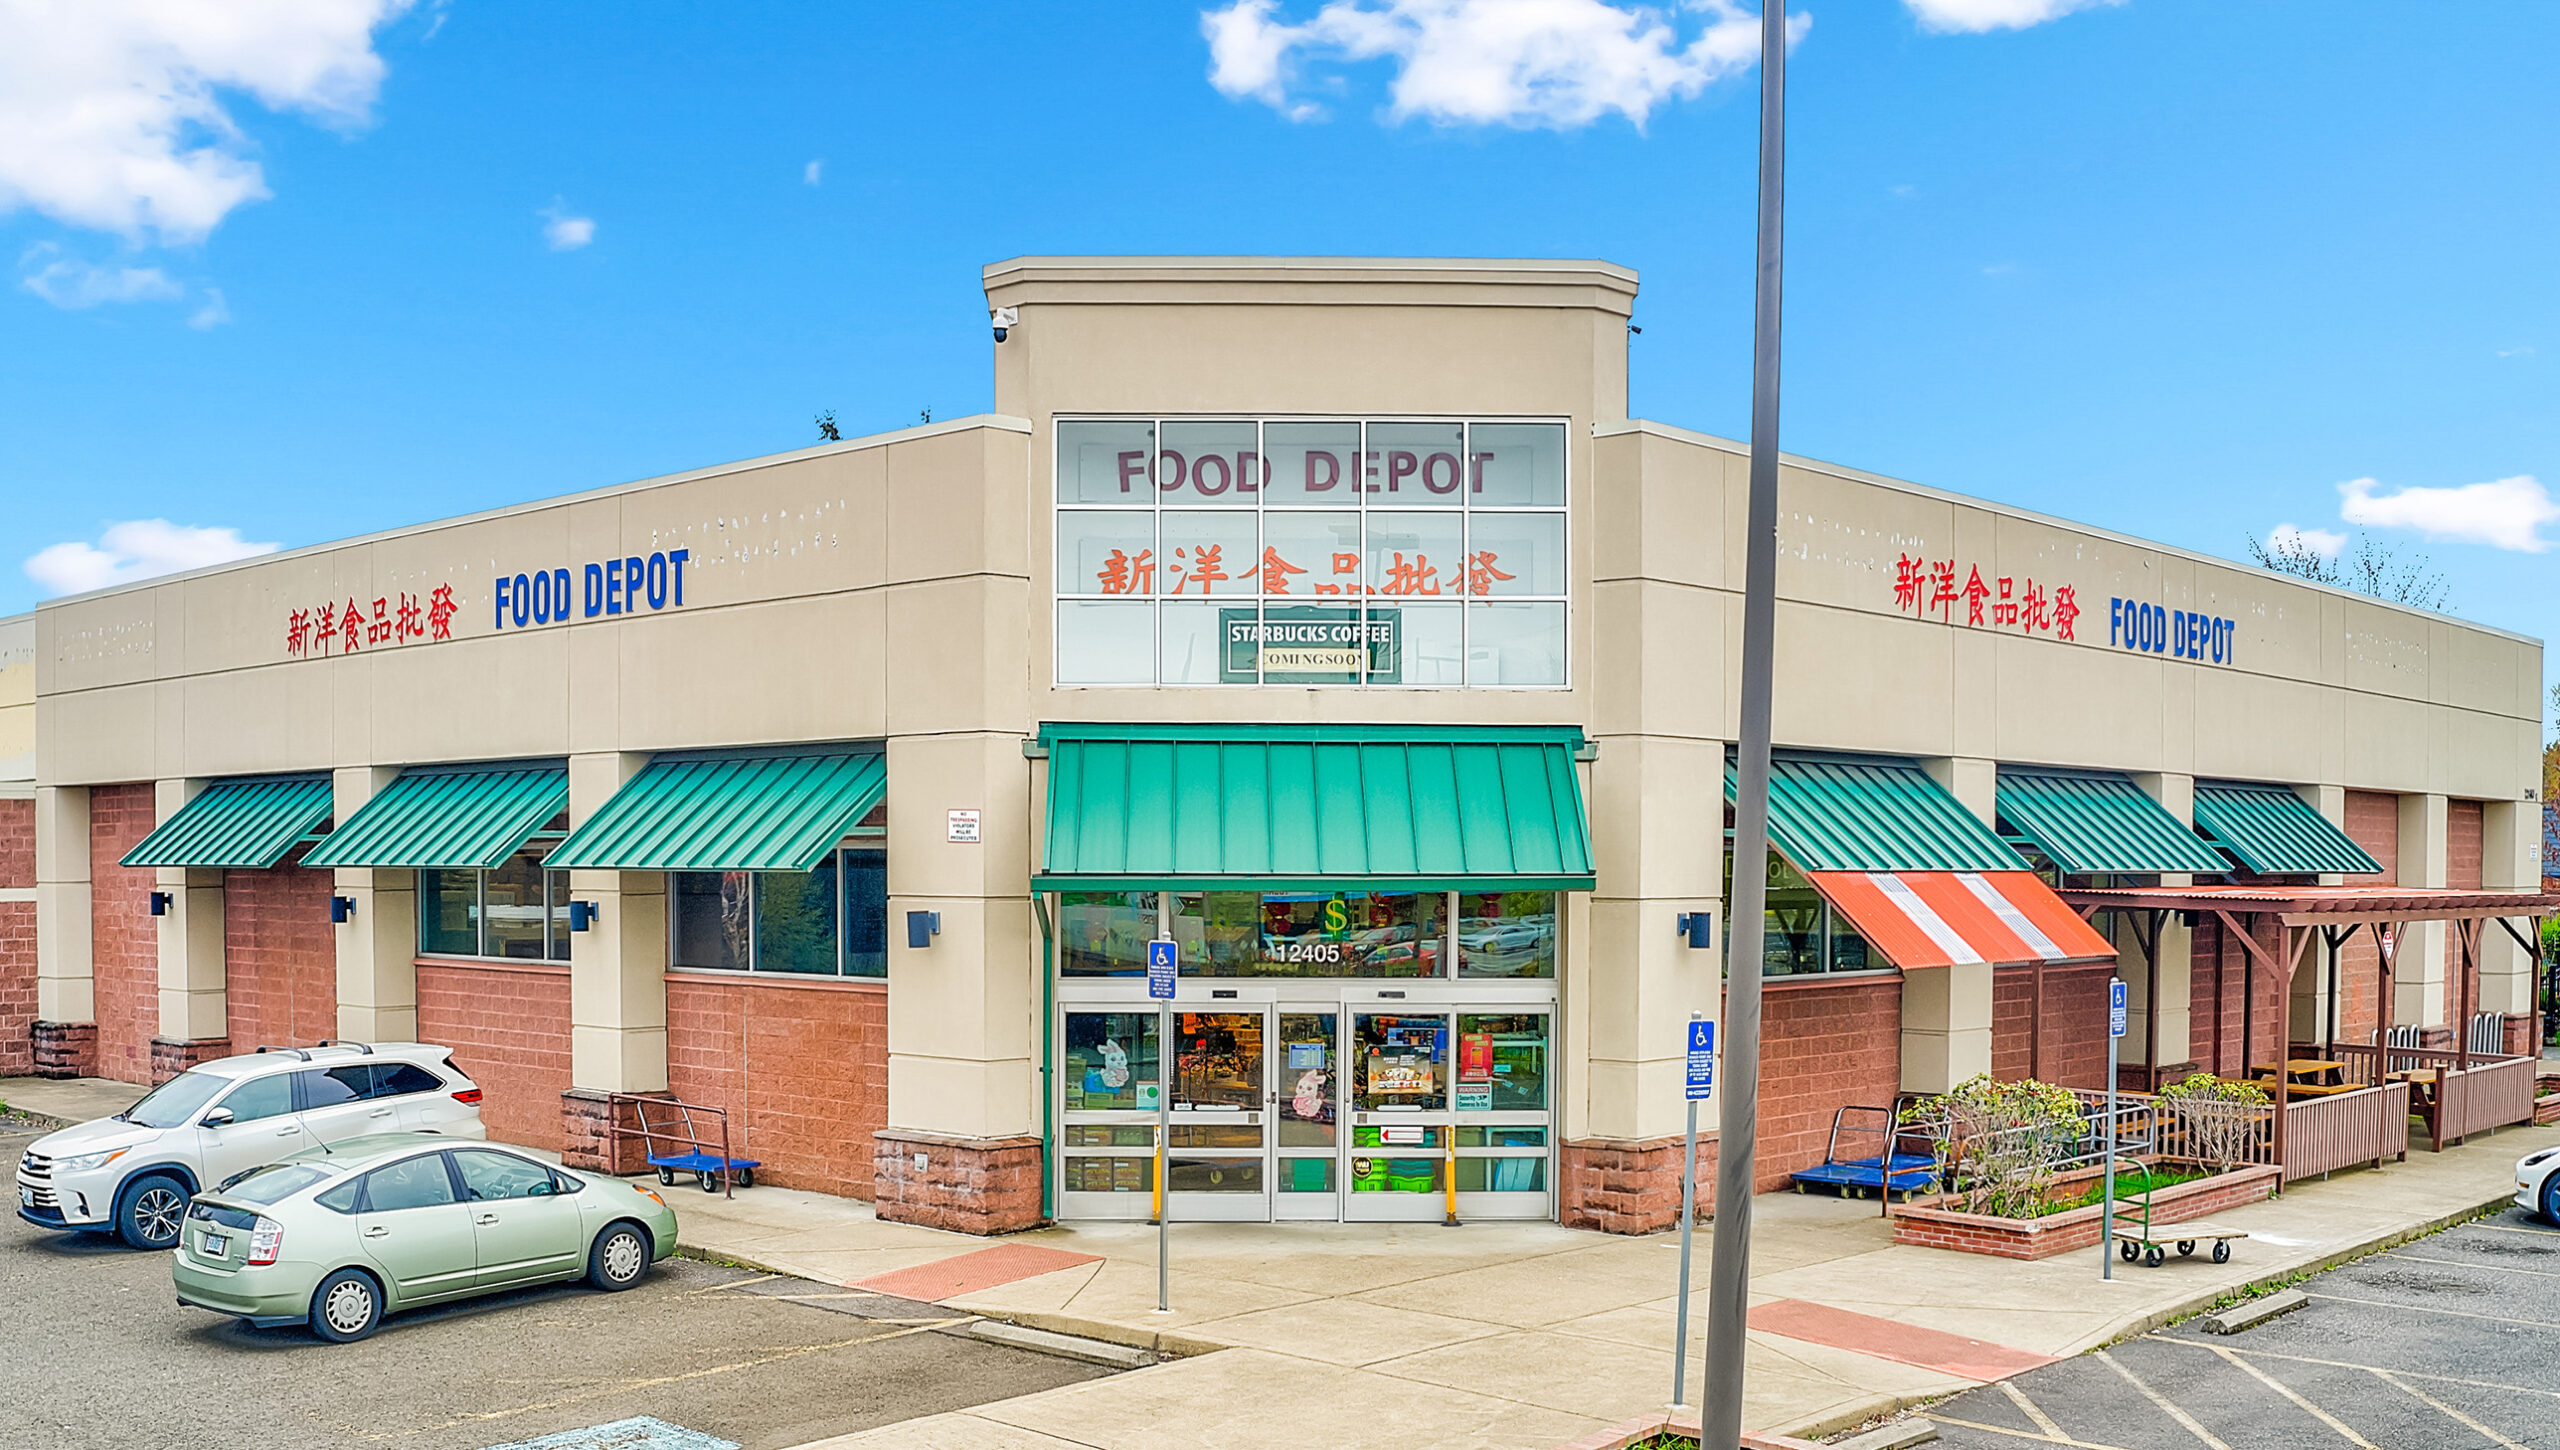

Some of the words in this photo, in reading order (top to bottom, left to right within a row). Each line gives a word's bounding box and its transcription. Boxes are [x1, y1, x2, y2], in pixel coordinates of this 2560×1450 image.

[1117, 449, 1271, 496] FOOD
[1305, 451, 1494, 494] DEPOT
[495, 565, 572, 629] FOOD
[584, 549, 690, 619] DEPOT
[1097, 544, 1516, 605] 新洋食品批發
[1893, 552, 2081, 642] 新洋食品批發
[287, 582, 458, 657] 新洋食品批發
[1231, 626, 1328, 642] STARBUCKS
[2110, 597, 2167, 654] FOOD
[2174, 610, 2236, 666] DEPOT
[1276, 944, 1340, 963] 12405
